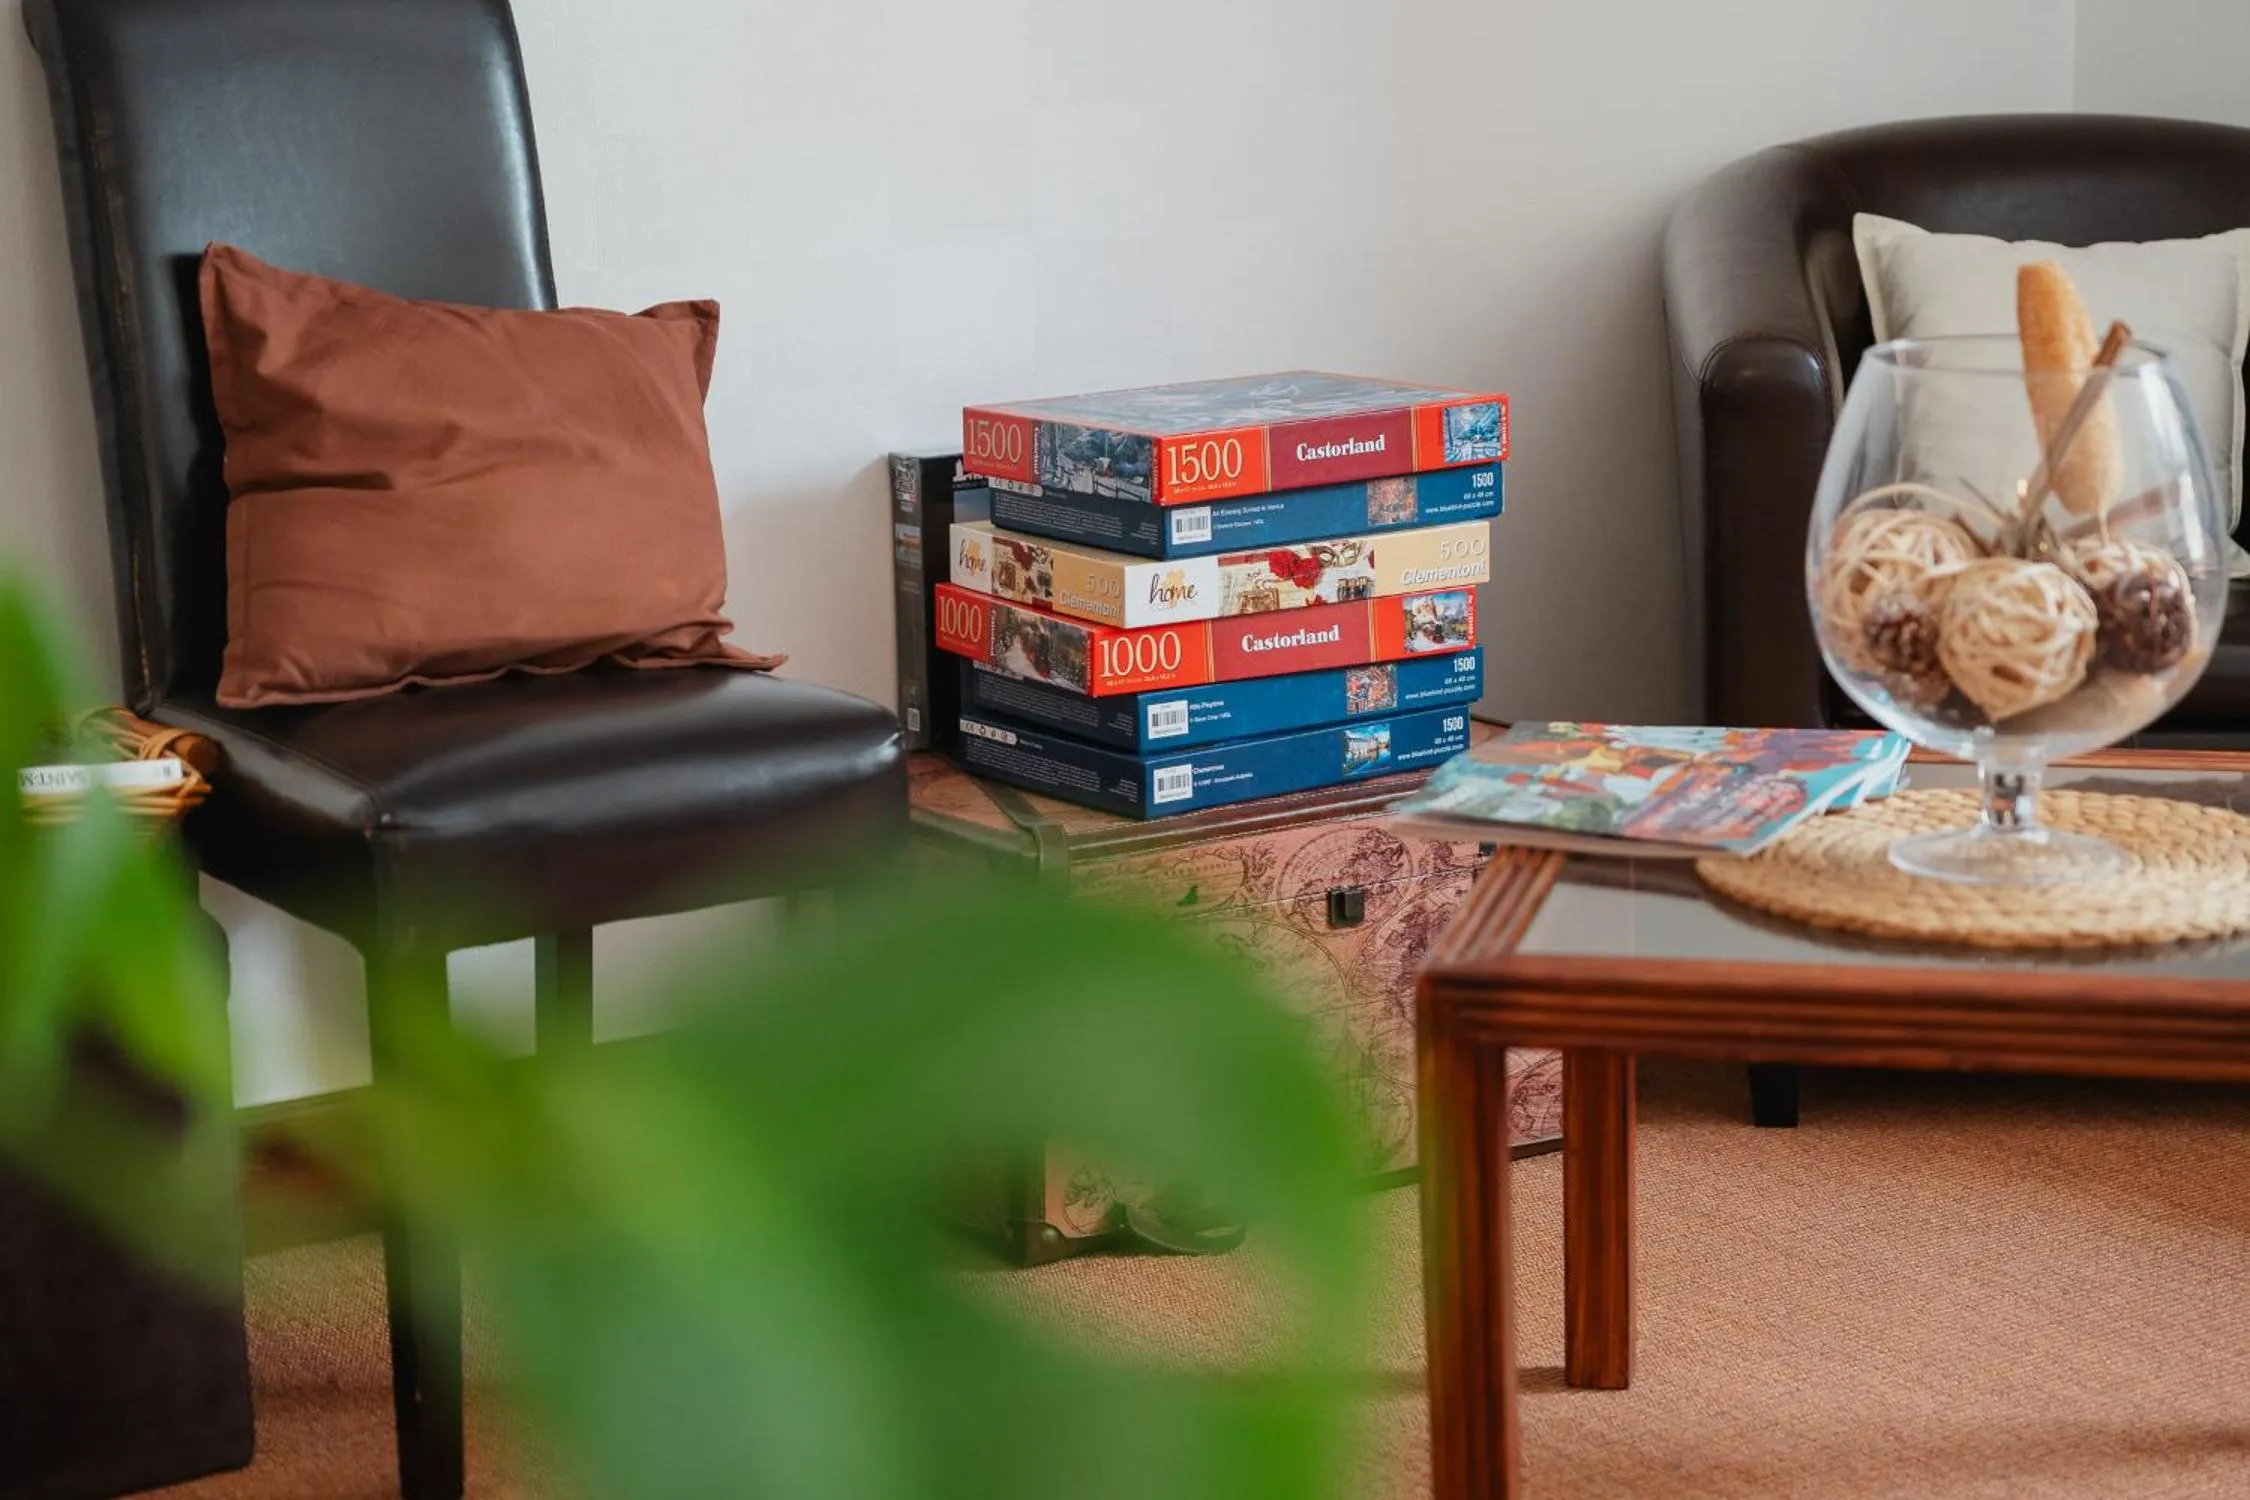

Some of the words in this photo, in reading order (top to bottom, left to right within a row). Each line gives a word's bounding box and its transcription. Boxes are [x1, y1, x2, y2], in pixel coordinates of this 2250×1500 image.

[968, 419, 1022, 463] 1500
[1296, 434, 1385, 462] Castorland
[1167, 438, 1243, 486] 1500
[1471, 472, 1494, 488] 1500
[1440, 539, 1486, 561] 500
[1403, 560, 1486, 585] Clementoni
[1149, 572, 1198, 604] home
[940, 596, 982, 643] 1000
[1059, 591, 1122, 620] Clementoni
[1241, 624, 1341, 653] Castorland
[1099, 631, 1182, 678] 1000
[1453, 656, 1476, 673] 1500
[1443, 716, 1464, 733] 1500
